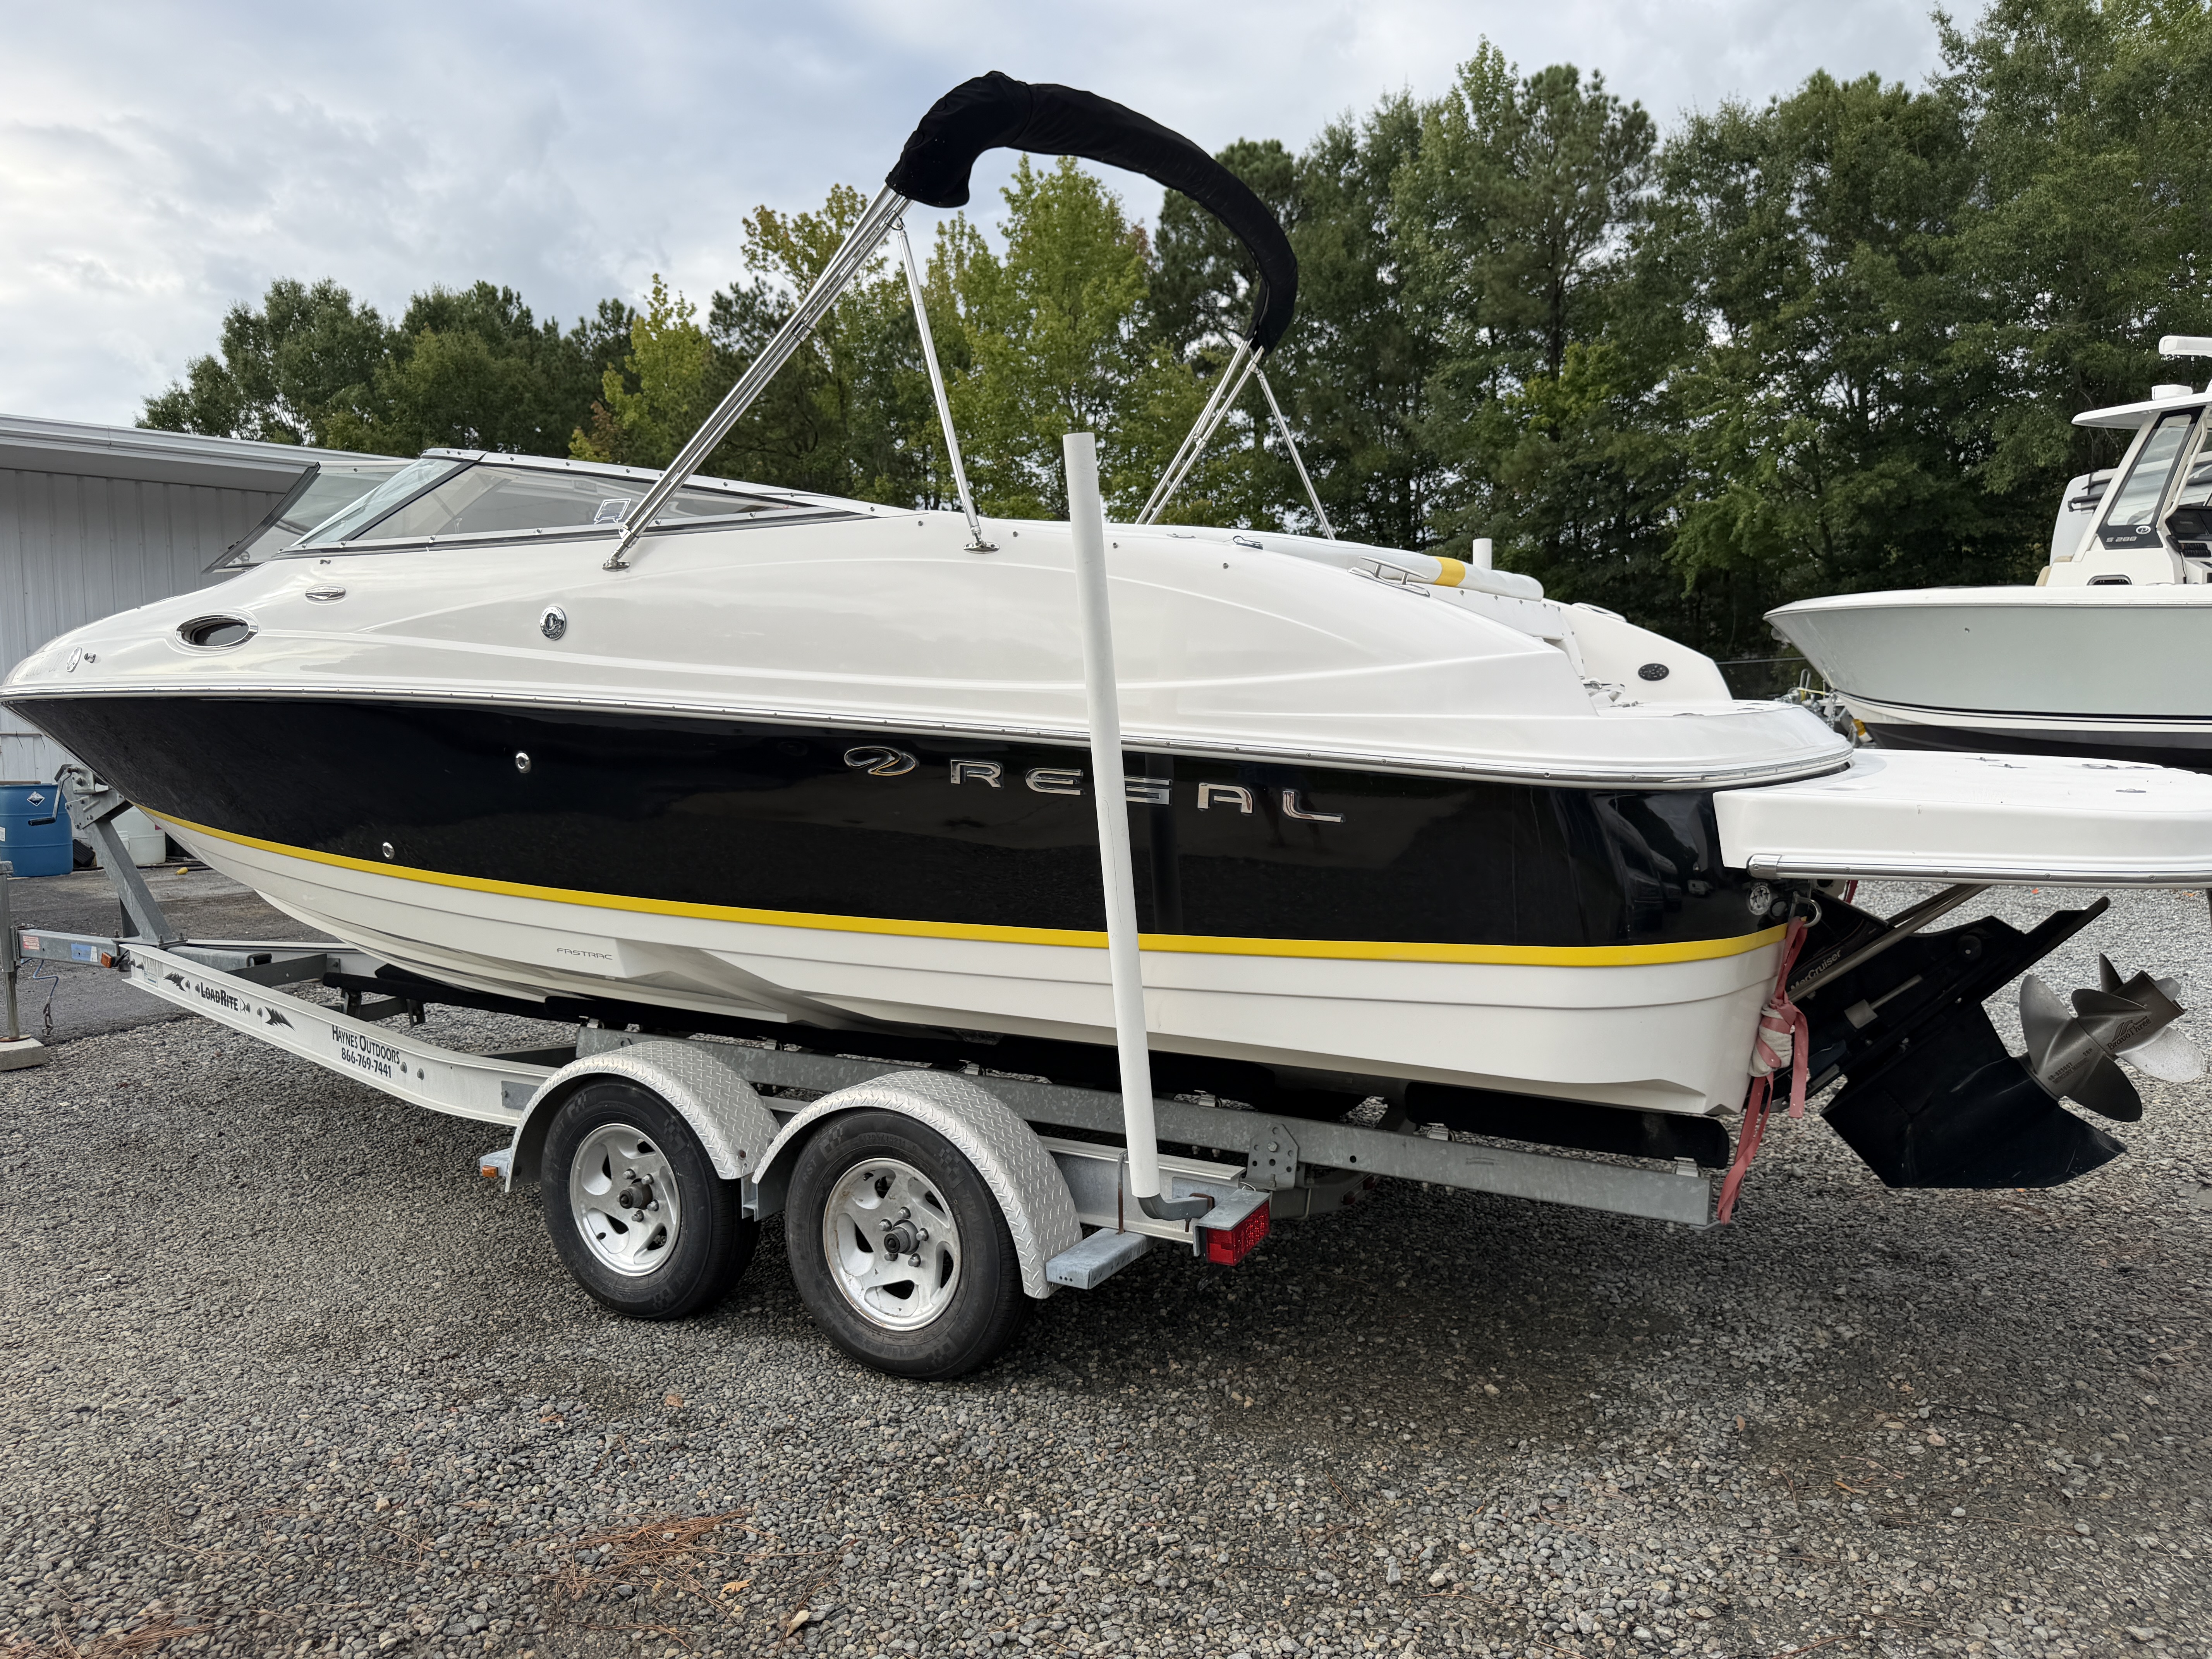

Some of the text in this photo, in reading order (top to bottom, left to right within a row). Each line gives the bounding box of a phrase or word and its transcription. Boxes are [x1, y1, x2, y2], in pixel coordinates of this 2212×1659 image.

[950, 758, 1344, 823] REGAL
[557, 948, 613, 960] FASTRAC
[332, 1024, 400, 1065] HAYNES OUTDOORS
[342, 1047, 391, 1078] 866-769-7441
